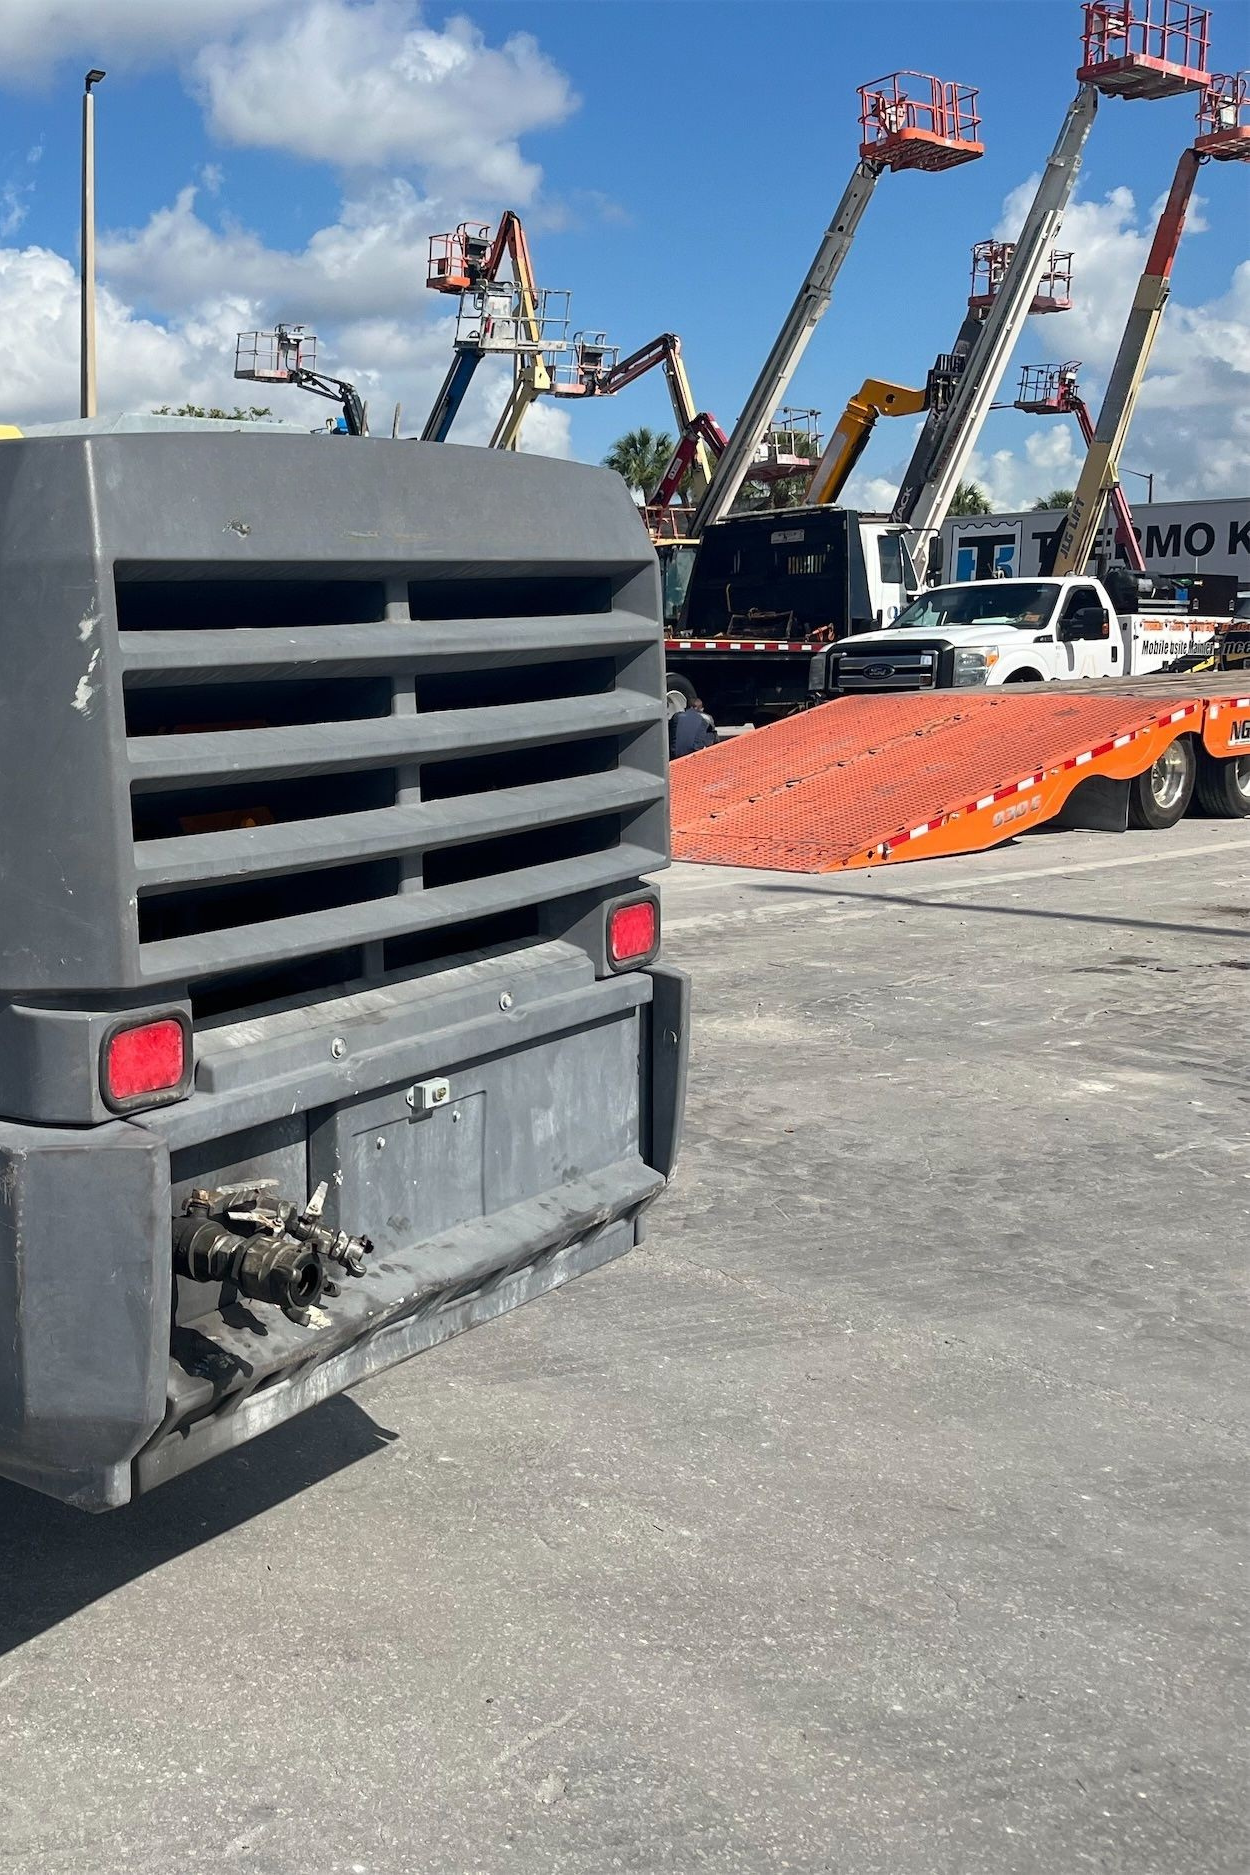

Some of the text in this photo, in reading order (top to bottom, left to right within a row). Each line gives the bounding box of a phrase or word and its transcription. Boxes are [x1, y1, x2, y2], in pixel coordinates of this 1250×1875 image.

[1031, 522, 1216, 563] TERMO
[1060, 496, 1085, 559] JLG LIFT
[1142, 640, 1169, 655] Mobile
